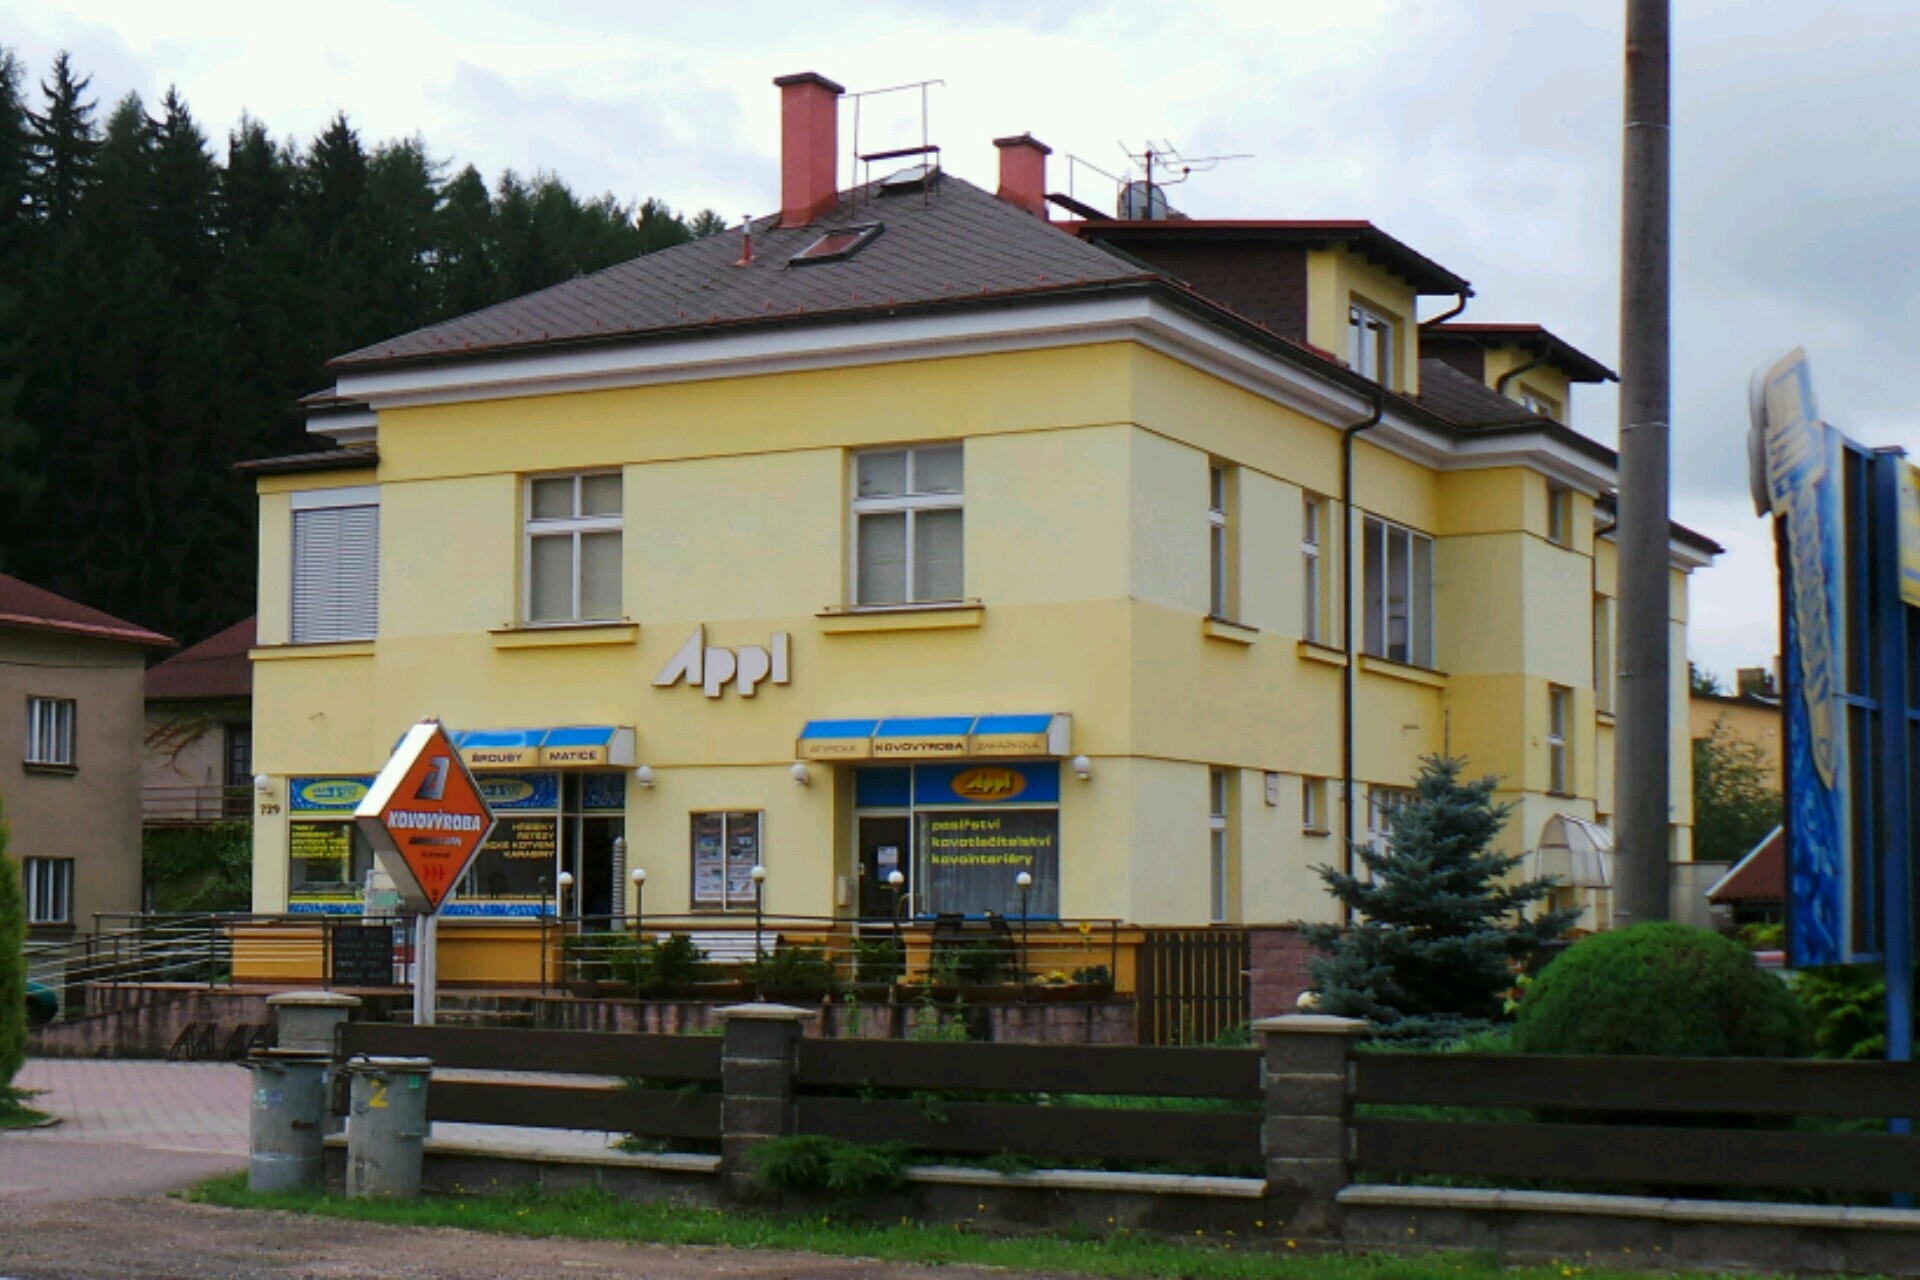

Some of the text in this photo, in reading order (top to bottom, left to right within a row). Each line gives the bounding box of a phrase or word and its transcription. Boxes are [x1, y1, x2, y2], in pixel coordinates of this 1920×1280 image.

[651, 623, 791, 698] Appl
[549, 751, 597, 760] MATICE
[875, 740, 963, 751] KOVOVÝROBA
[966, 772, 1010, 792] Appl
[388, 809, 481, 831] KOVOVÝROBA
